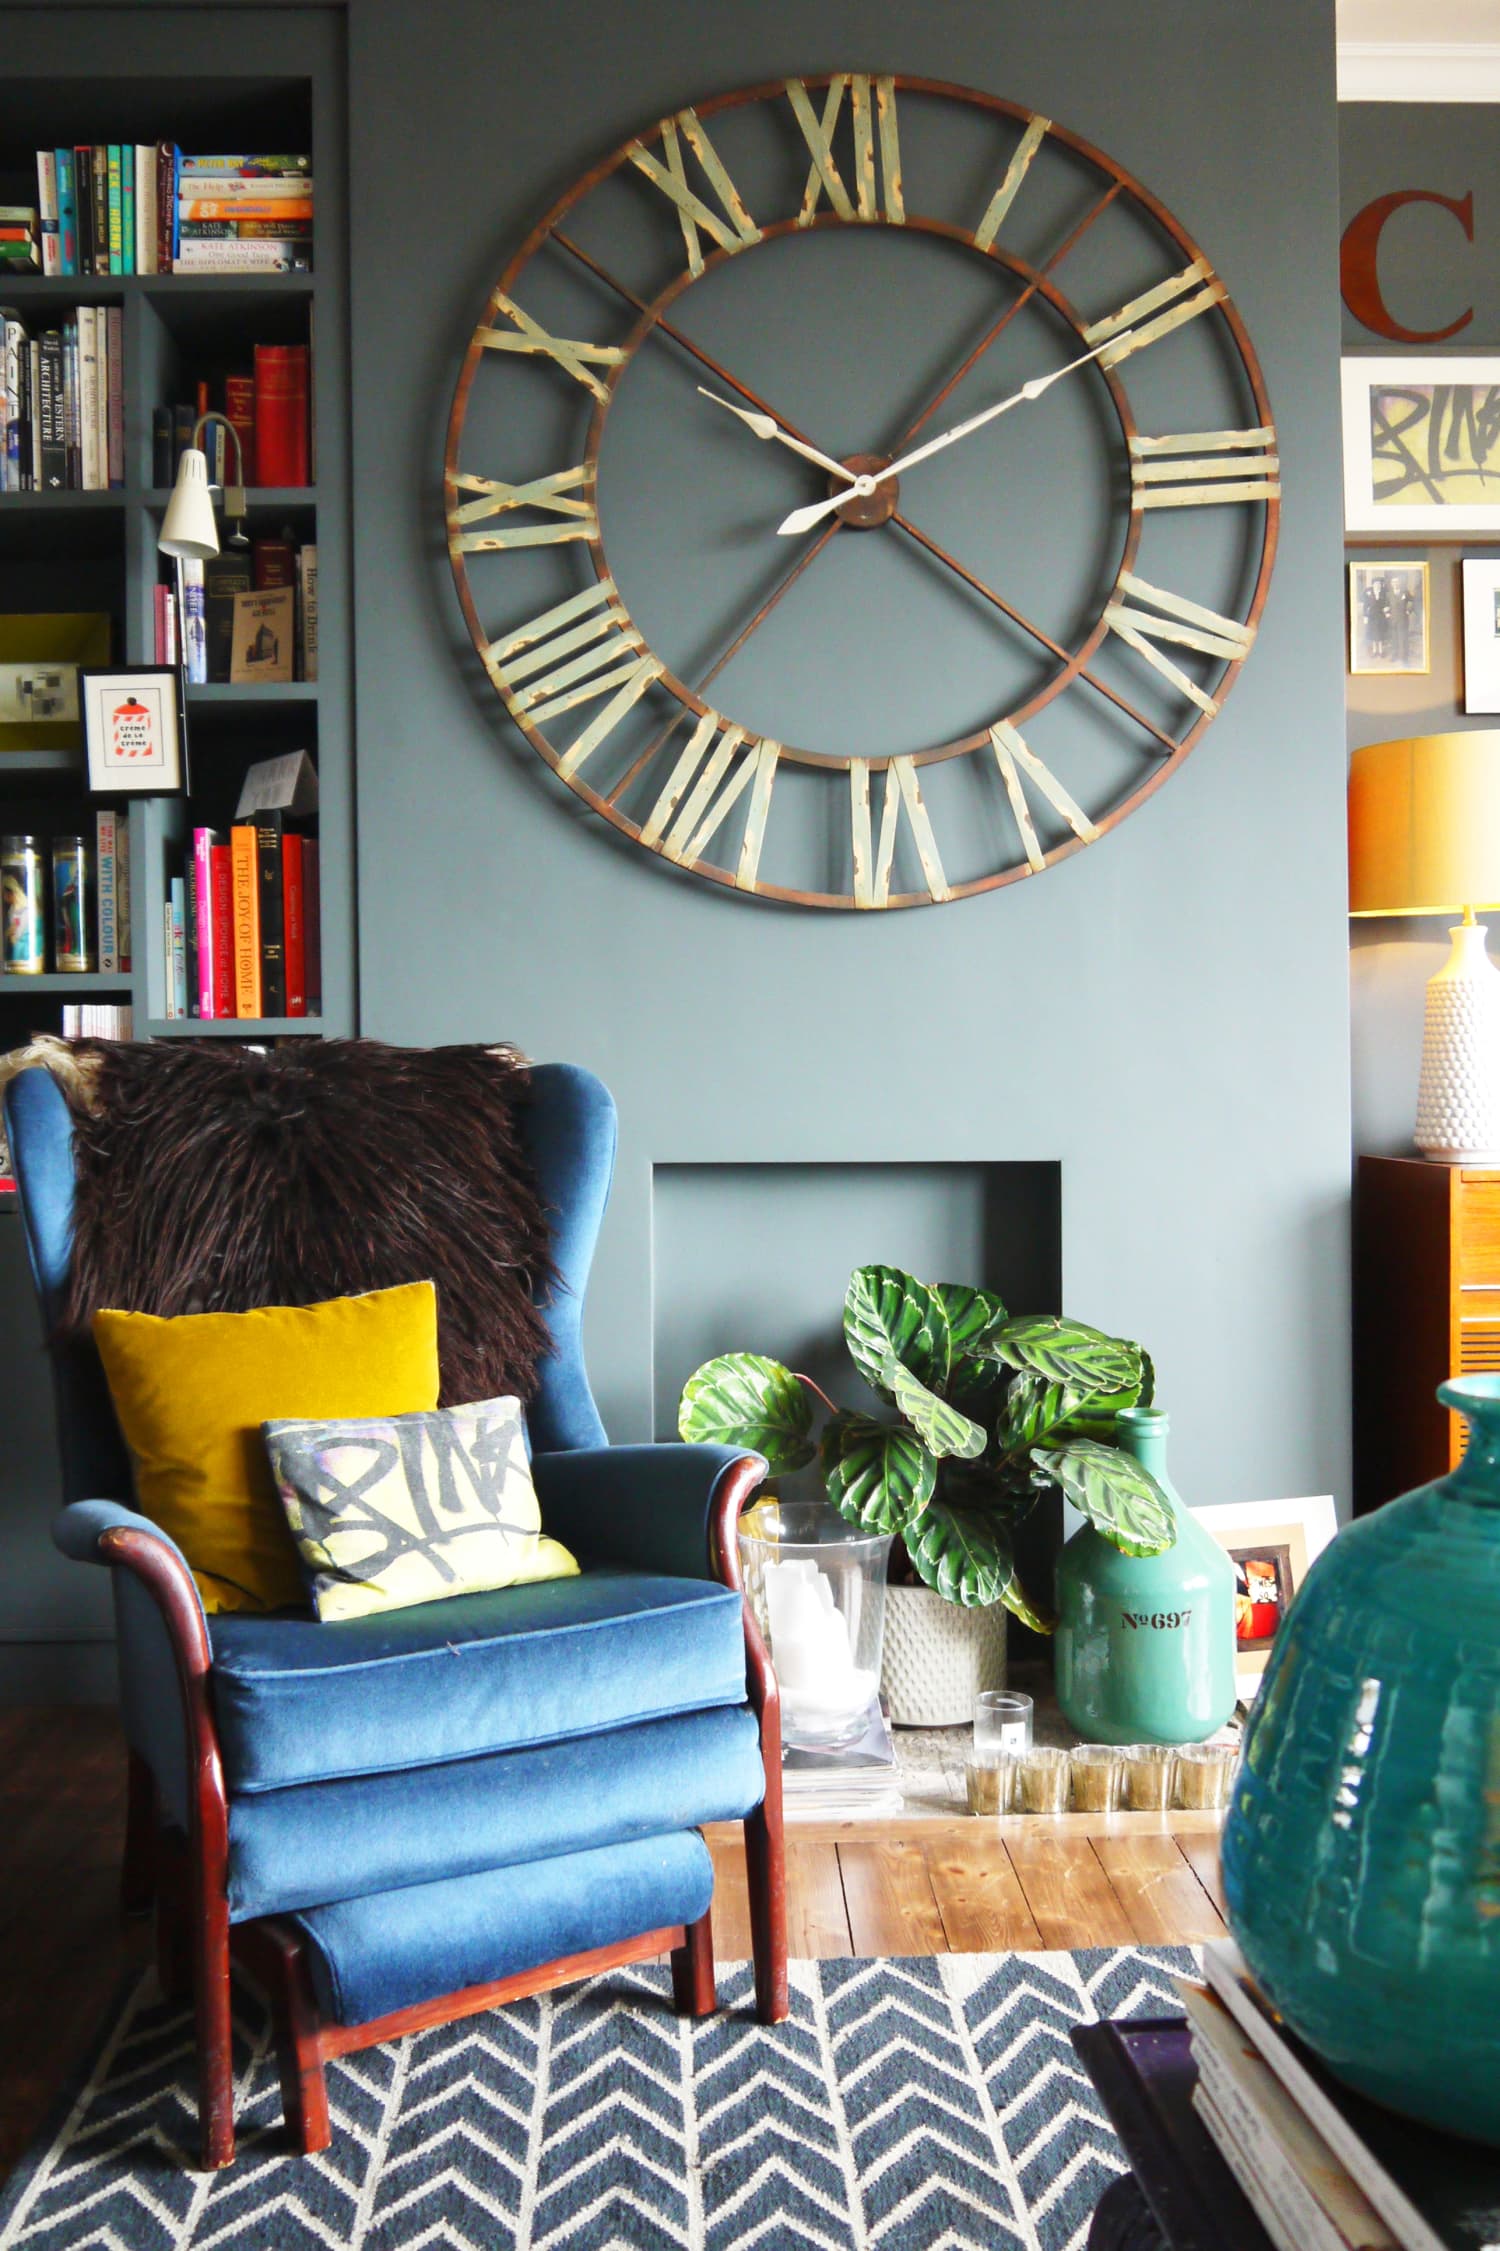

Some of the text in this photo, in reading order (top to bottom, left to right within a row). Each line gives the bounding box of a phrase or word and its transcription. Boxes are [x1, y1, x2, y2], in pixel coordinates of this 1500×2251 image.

[625, 107, 762, 279] XI
[786, 72, 907, 227] XII
[974, 115, 1052, 252] I
[1081, 256, 1230, 371] II
[1340, 189, 1474, 343] C
[41, 357, 52, 441] ARCHITECTURE
[474, 286, 632, 405] X
[55, 393, 64, 441] WESTERN
[1130, 426, 1281, 510] III
[448, 463, 598, 554] IX
[307, 568, 317, 596] How
[1103, 570, 1257, 719] IV
[485, 575, 668, 782] VIII
[639, 710, 781, 892] VII
[851, 755, 952, 910] VI
[989, 719, 1101, 874] V
[101, 857, 114, 953] WITH COLOUR
[237, 856, 253, 994] THE JOY OF HOME
